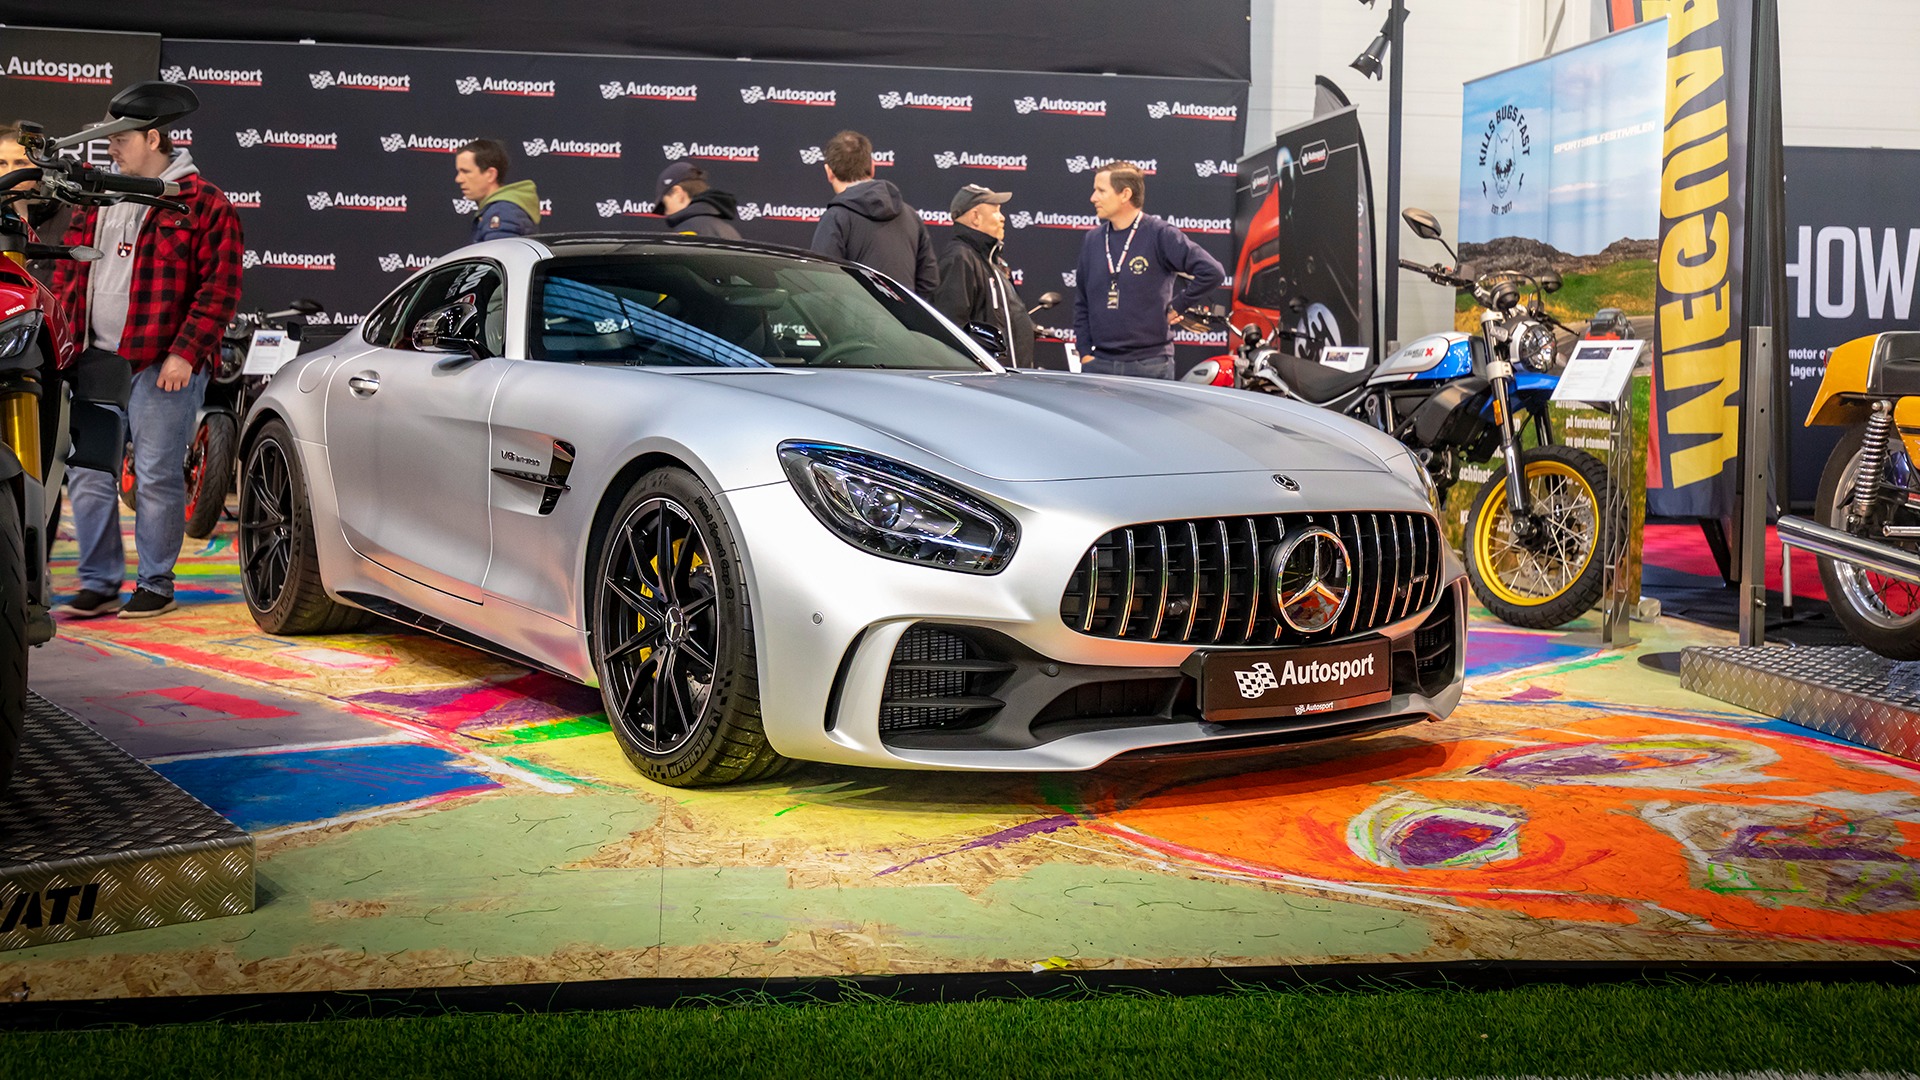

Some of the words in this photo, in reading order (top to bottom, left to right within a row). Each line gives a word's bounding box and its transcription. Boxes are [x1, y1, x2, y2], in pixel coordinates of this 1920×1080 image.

[7, 56, 113, 81] Autosport
[188, 66, 262, 84] Autosport
[336, 71, 410, 90] Autosport
[483, 77, 555, 94] Autosport
[626, 81, 697, 99] Autosport
[767, 86, 836, 104] Autosport
[904, 91, 973, 109] Autosport
[1039, 97, 1107, 115] Autosport
[1171, 101, 1237, 119] Autosport
[264, 129, 337, 147] Autosport
[407, 134, 478, 152] Autospo
[1479, 120, 1495, 166] KILLS
[1496, 104, 1518, 125] BUGS
[1517, 114, 1530, 156] FAST
[1553, 120, 1656, 154] SPORTSBILFESTIVALEN
[550, 138, 621, 156] Autosport
[689, 142, 759, 160] Autosport
[959, 151, 1027, 168] Autosport
[224, 190, 261, 205] sport
[334, 192, 407, 210] Autosport
[1501, 200, 1512, 215] 2017
[1035, 211, 1100, 228] Autospor
[1167, 215, 1231, 232] Autosport
[262, 251, 336, 268] Autosport
[1173, 330, 1228, 344] utosport
[1788, 348, 1818, 360] motor
[501, 450, 514, 461] V8
[1459, 464, 1495, 484] schönst
[708, 520, 726, 558] Sport
[1281, 652, 1375, 686] Autosport
[1305, 702, 1334, 712] Autosport
[668, 727, 714, 778] MICHELIN
[0, 883, 100, 933] ATI
